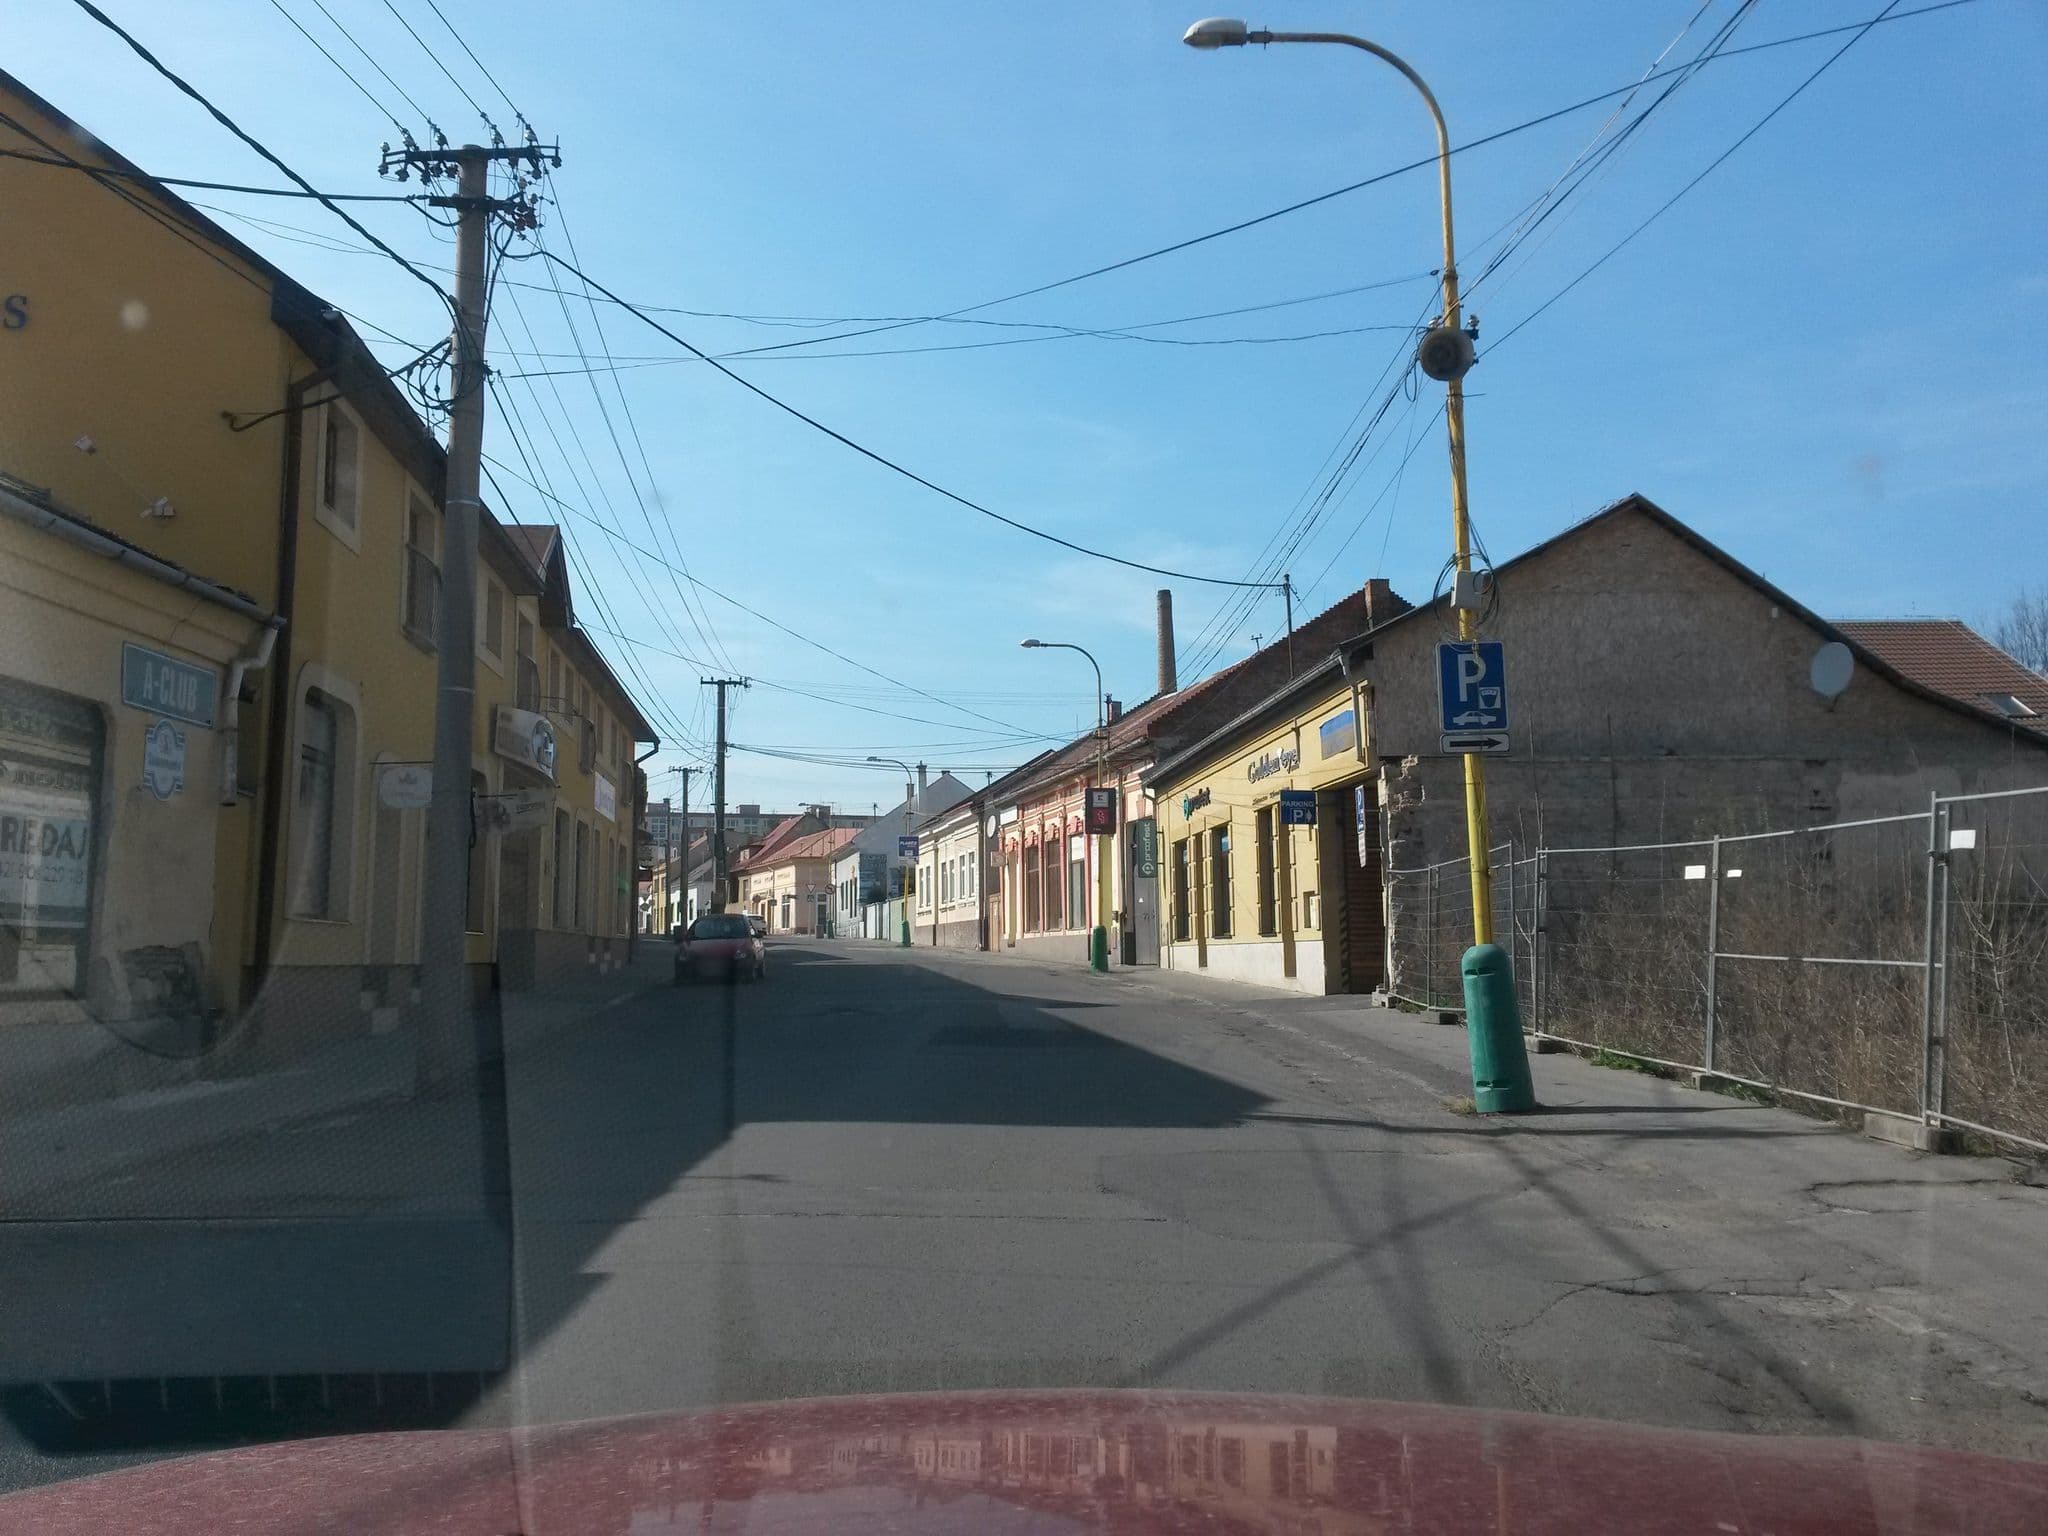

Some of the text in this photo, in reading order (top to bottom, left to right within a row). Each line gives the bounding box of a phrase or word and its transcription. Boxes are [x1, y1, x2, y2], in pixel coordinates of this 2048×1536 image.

[3, 294, 29, 330] S
[142, 661, 199, 713] A-CLUB
[1457, 653, 1487, 702] P
[1281, 800, 1315, 808] PARKING
[1293, 809, 1304, 823] P
